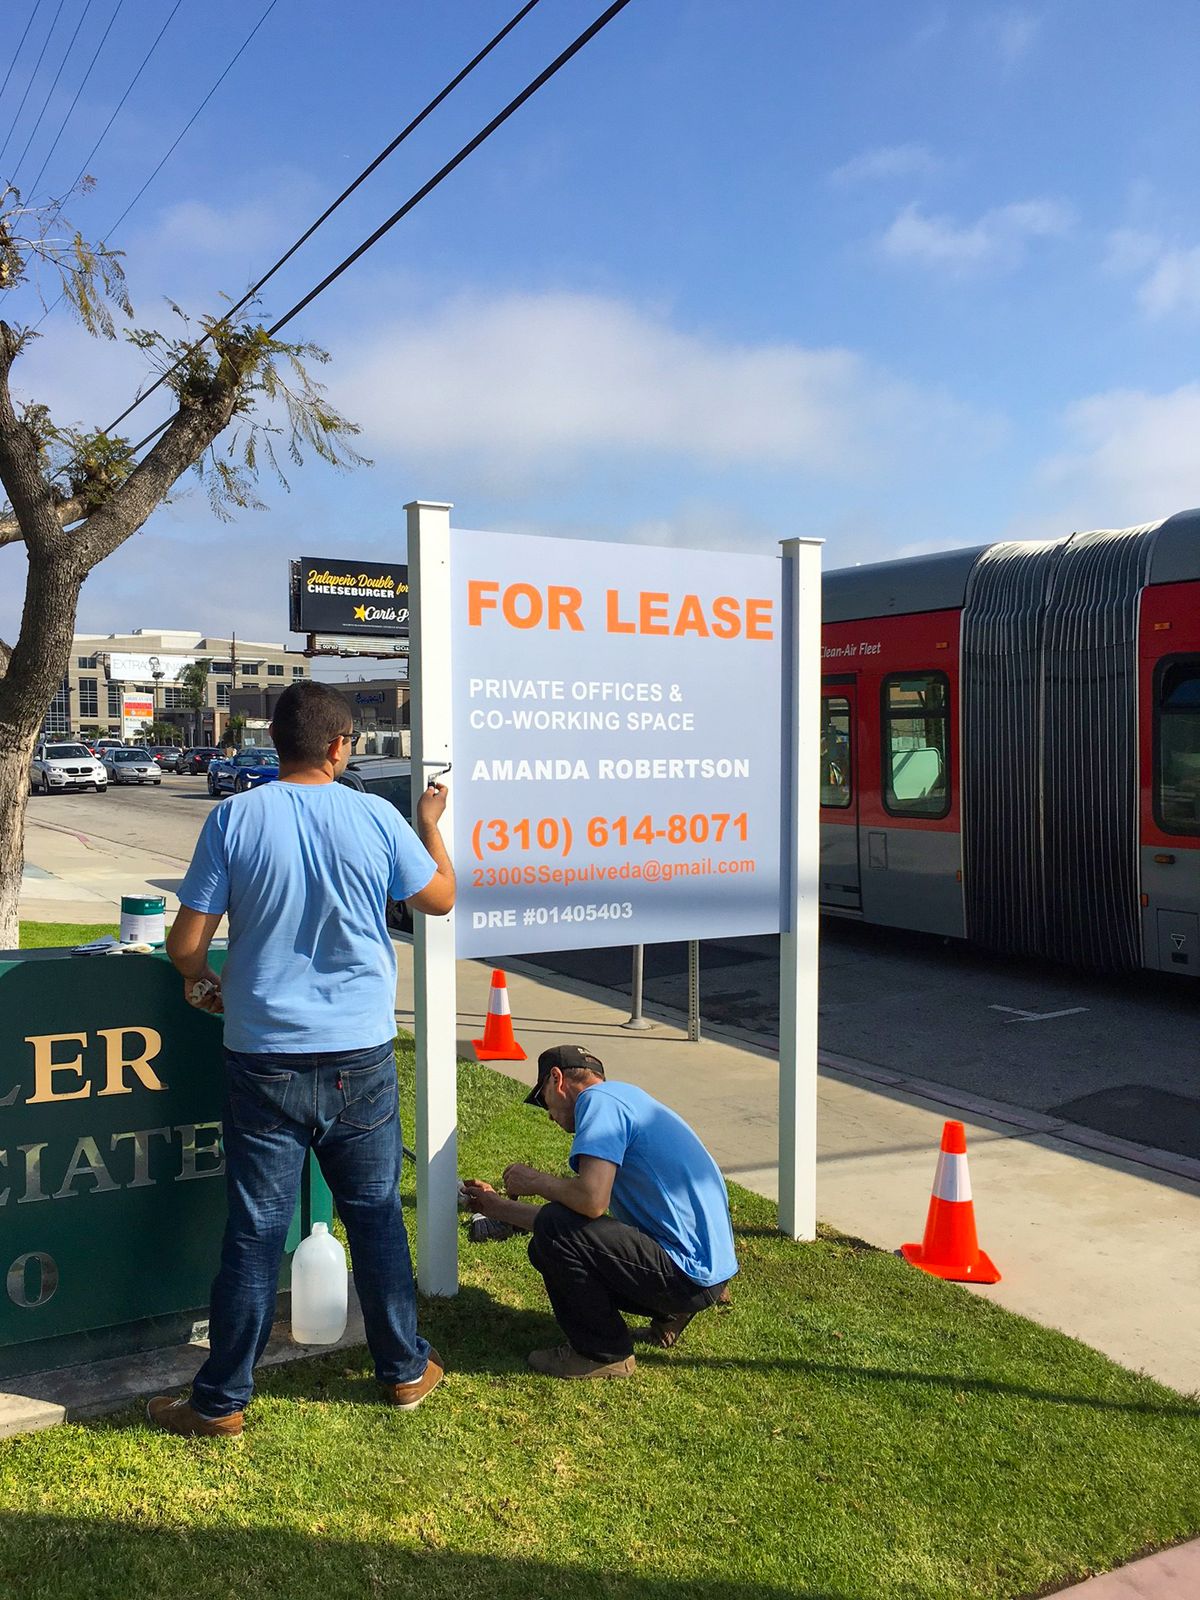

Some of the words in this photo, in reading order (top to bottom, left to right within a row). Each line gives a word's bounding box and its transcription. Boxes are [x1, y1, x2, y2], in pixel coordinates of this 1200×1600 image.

[307, 569, 357, 587] Jalapeño
[357, 573, 394, 589] Double
[307, 585, 395, 599] CHEESEBURGER
[365, 606, 397, 621] Carl's
[468, 580, 585, 632] FOR
[606, 588, 774, 641] LEASE
[859, 642, 881, 656] Fleet
[469, 678, 565, 700] PRIVATE
[571, 681, 663, 702] OFFICES
[669, 684, 683, 702] &
[469, 709, 620, 731] CO-WORKING
[626, 712, 695, 731] SPACE
[471, 759, 590, 781] AMANDA
[598, 758, 750, 780] ROBERTSON
[472, 816, 573, 861] (310)
[587, 812, 750, 848] 614-8071
[472, 858, 756, 887] 2300SSepulveda@gmail.com
[472, 909, 517, 930] DRE
[523, 902, 633, 926] #01405403
